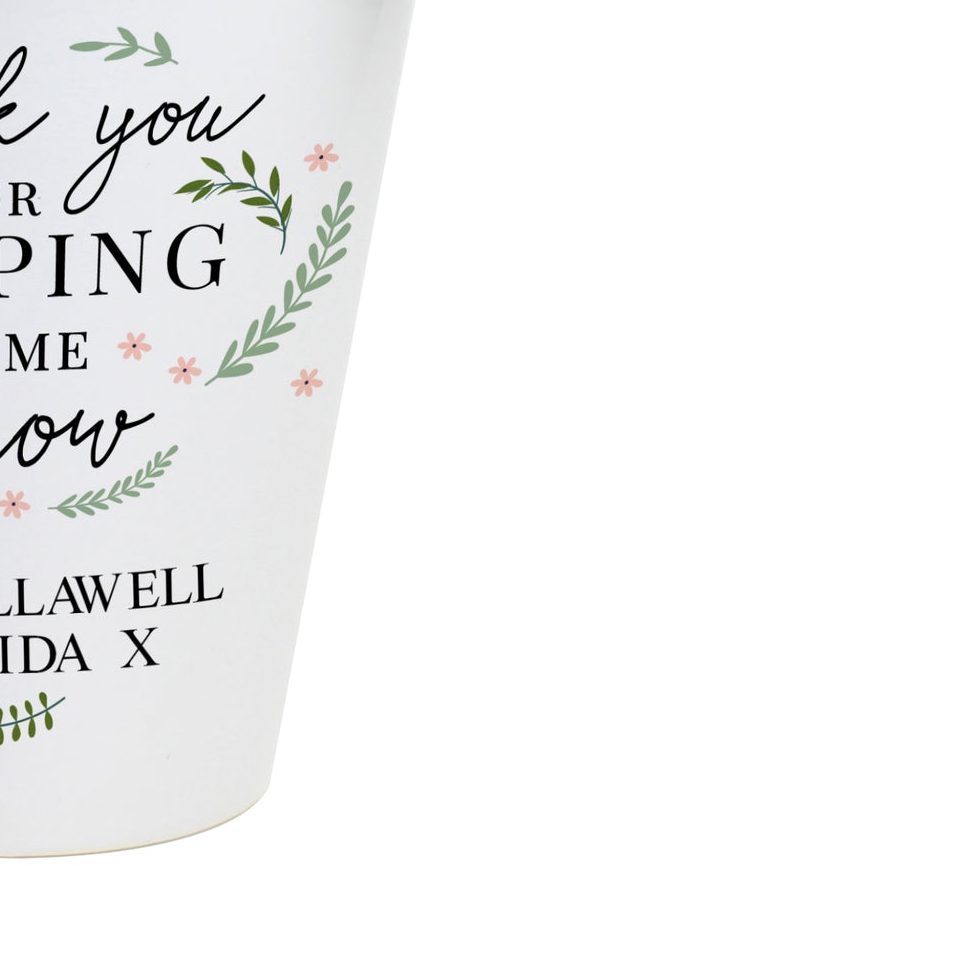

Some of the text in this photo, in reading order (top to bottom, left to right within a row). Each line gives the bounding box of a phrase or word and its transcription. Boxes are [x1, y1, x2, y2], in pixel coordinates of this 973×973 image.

[63, 94, 266, 215] you
[5, 331, 88, 372] ME
[122, 627, 159, 669] X
